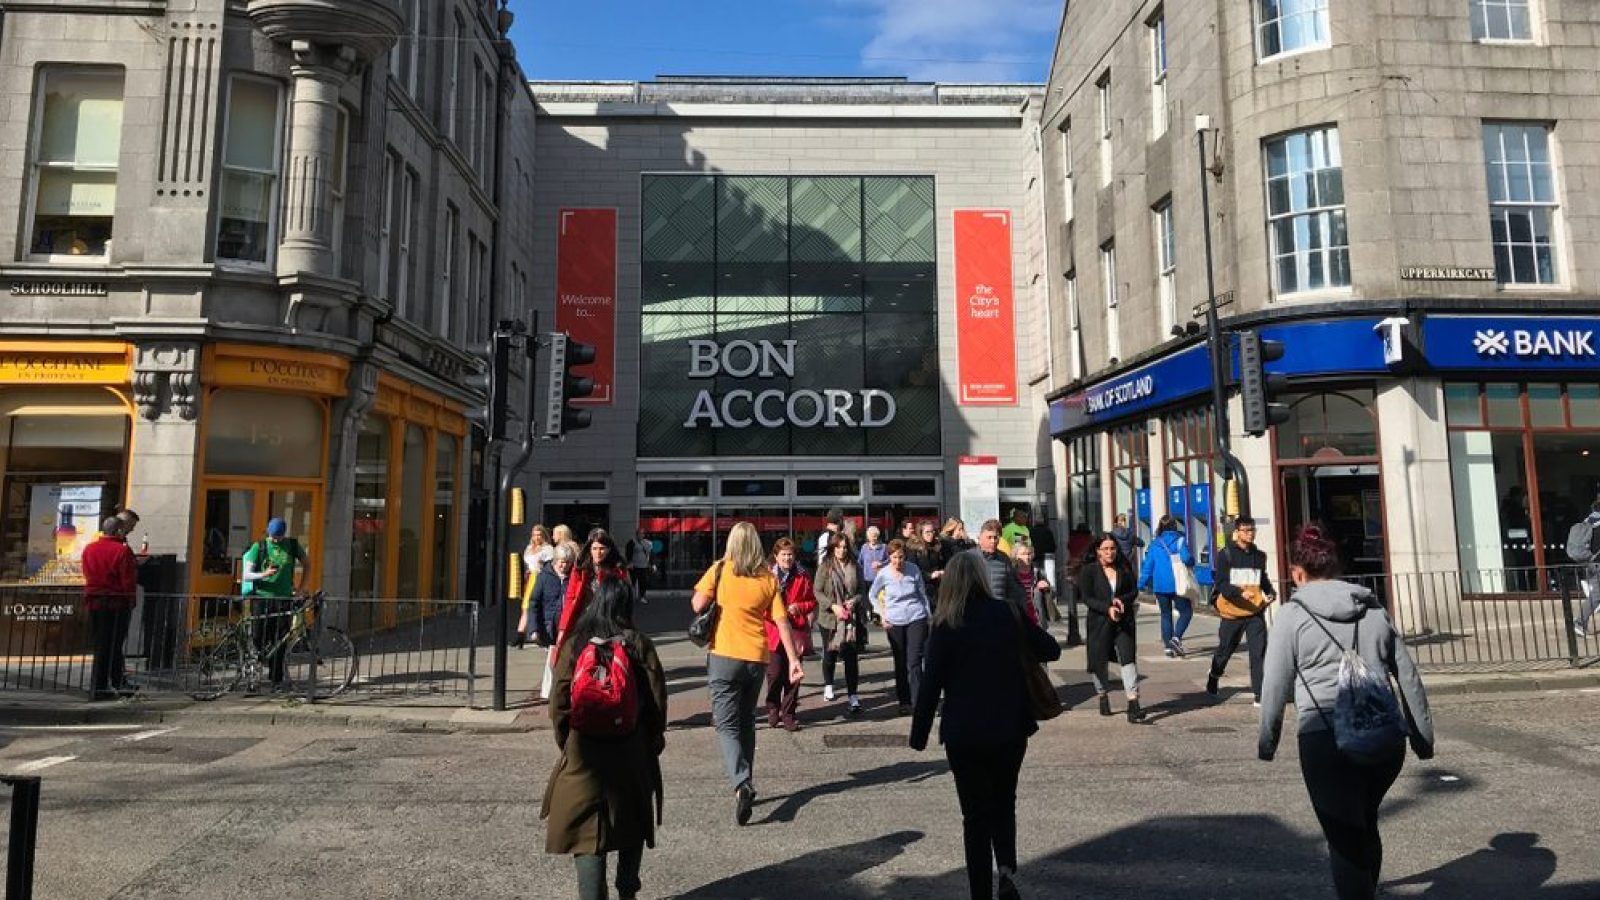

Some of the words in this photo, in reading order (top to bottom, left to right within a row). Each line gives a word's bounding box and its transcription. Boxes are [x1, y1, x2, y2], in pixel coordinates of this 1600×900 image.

[1400, 267, 1495, 279] UPPERKIRKGATE
[10, 283, 106, 295] SCHOOLHILL
[975, 284, 992, 295] the
[560, 294, 611, 305] Welcome
[969, 295, 1000, 308] City's
[971, 308, 1000, 318] heart
[1514, 330, 1596, 355] BANK
[688, 339, 798, 378] BON
[1115, 375, 1152, 404] SCOTLAND
[683, 389, 897, 428] ACCORD
[4, 603, 74, 616] L'OCCITANE
